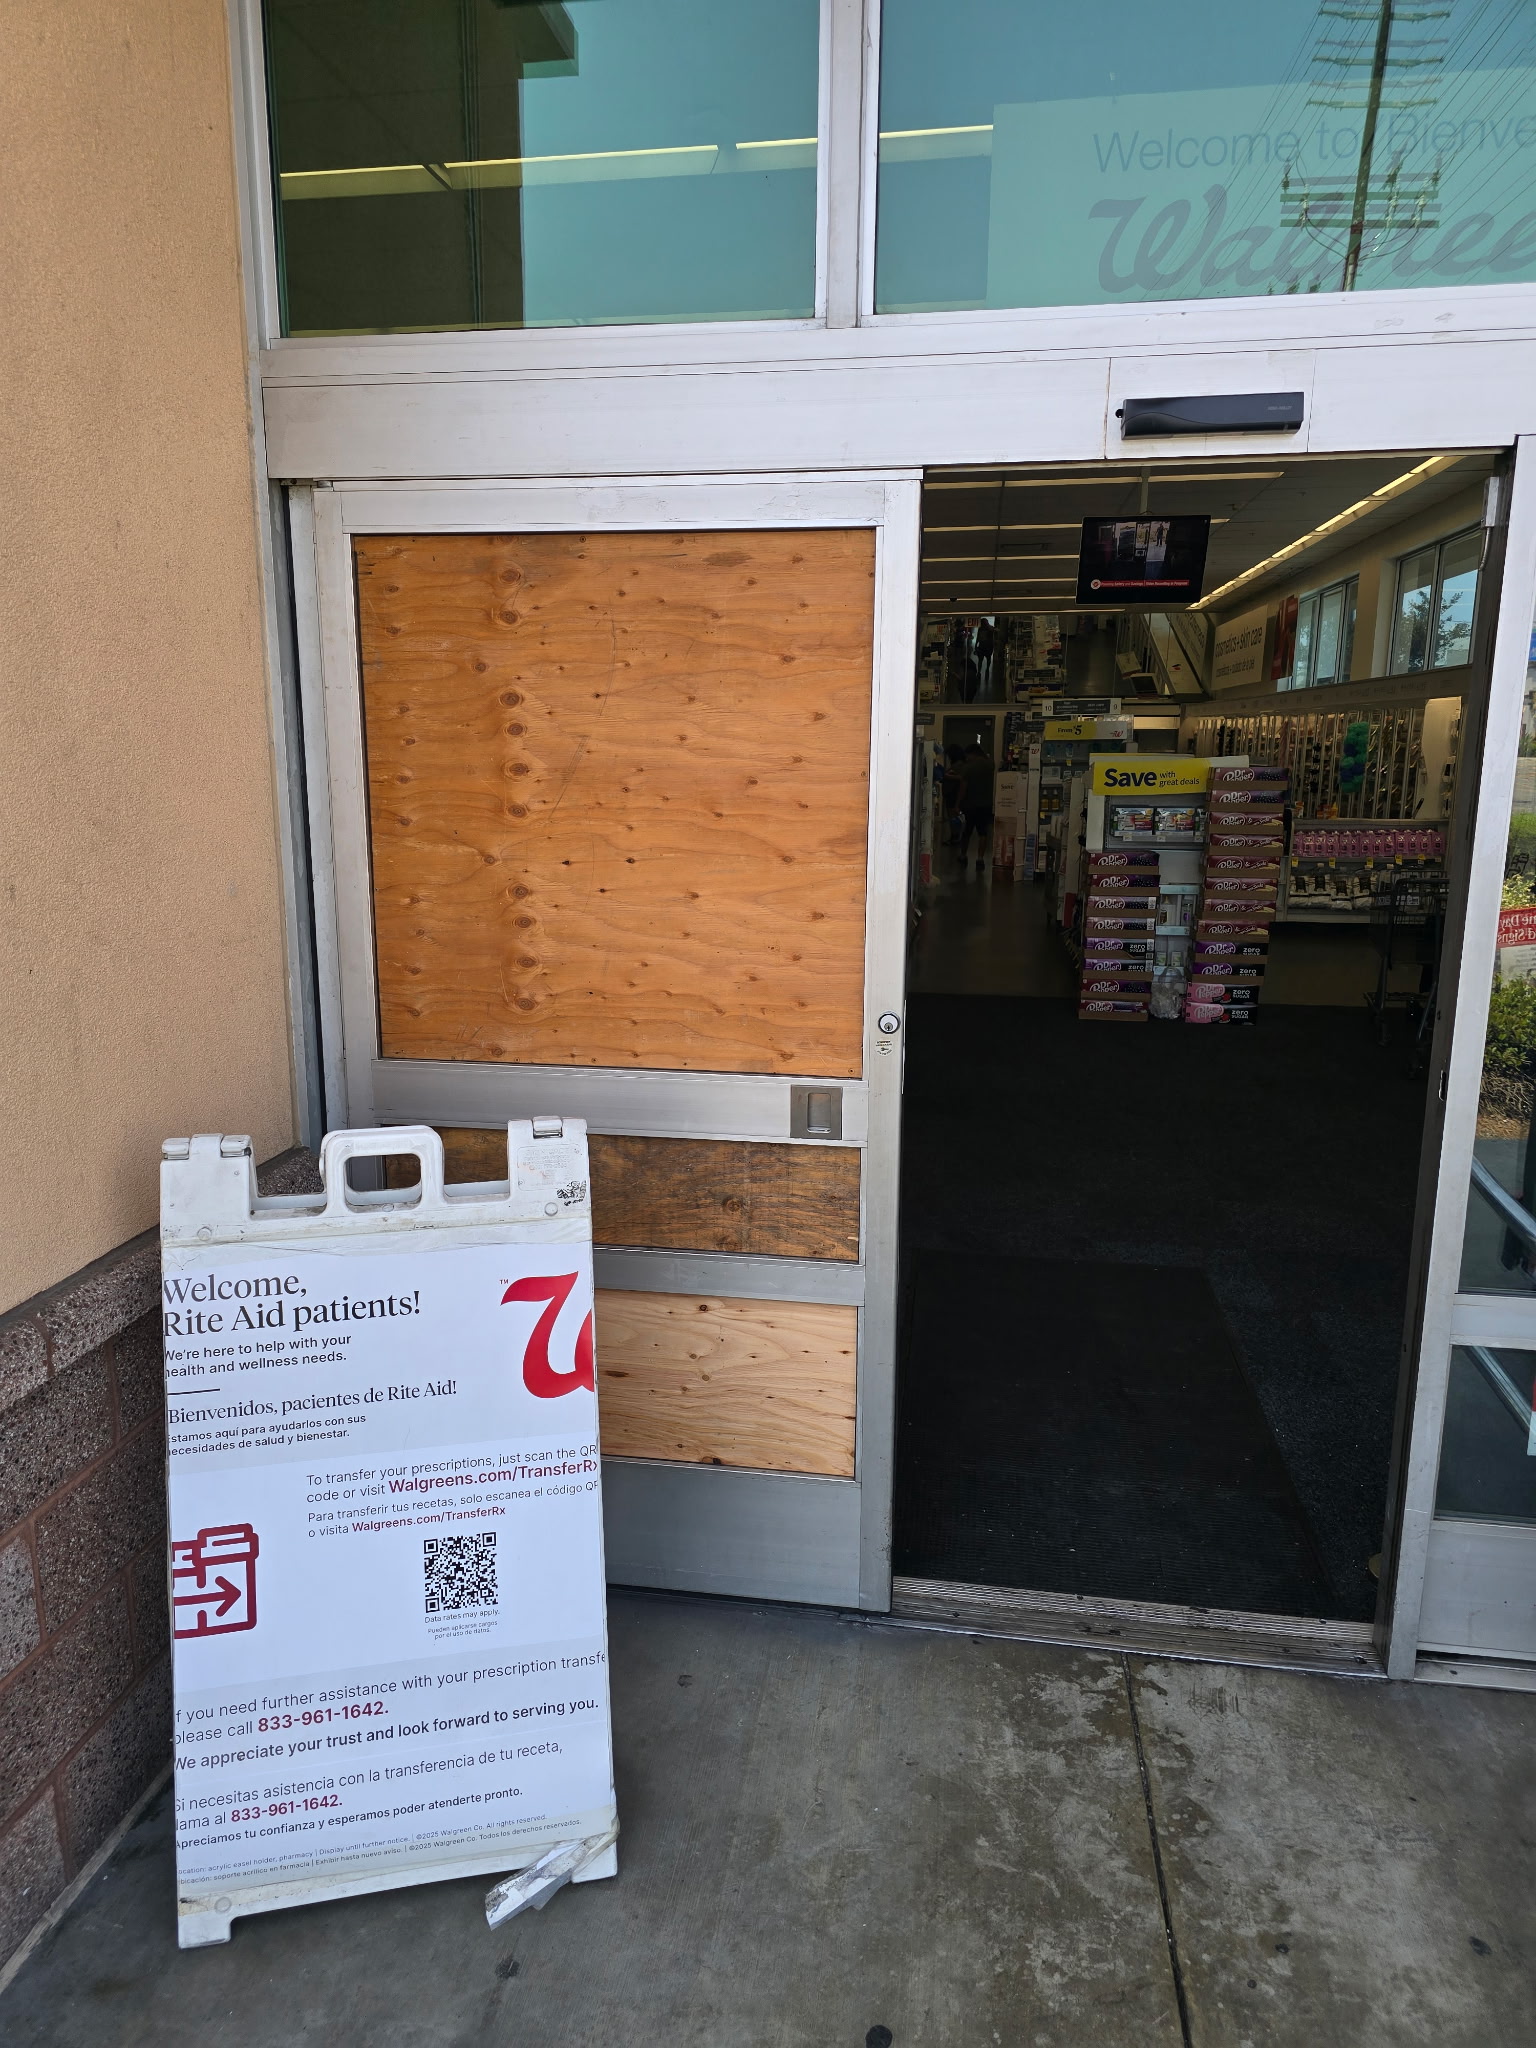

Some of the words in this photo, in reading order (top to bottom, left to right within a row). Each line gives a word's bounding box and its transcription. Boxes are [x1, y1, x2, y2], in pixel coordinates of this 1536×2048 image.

[1093, 128, 1299, 173] Welcome
[1316, 120, 1359, 160] to
[1104, 768, 1157, 787] Save
[1159, 771, 1176, 779] with
[1159, 779, 1178, 788] great
[1180, 777, 1200, 785] deals
[1196, 987, 1223, 999] Pepper
[1194, 1006, 1222, 1019] Pepper
[164, 1273, 307, 1304] Welcome,
[165, 1308, 224, 1336] Rite
[230, 1299, 286, 1332] Aid
[292, 1290, 420, 1333] patients!
[203, 1346, 235, 1358] here
[237, 1344, 252, 1355] to
[255, 1340, 285, 1354] help
[288, 1336, 318, 1350] with
[320, 1335, 352, 1350] your
[208, 1360, 235, 1374] and
[238, 1356, 299, 1371] wellness
[301, 1350, 347, 1365] needs.
[169, 1399, 278, 1424] Bienvenidos,
[281, 1393, 360, 1415] pacientes
[363, 1386, 384, 1404] de
[386, 1384, 420, 1401] Rite
[422, 1379, 457, 1398] Aid!
[168, 1432, 212, 1443] stamos
[214, 1426, 239, 1440] aquí
[241, 1425, 266, 1438] para
[268, 1419, 322, 1434] ayudarlos
[324, 1417, 345, 1427] con
[346, 1415, 367, 1424] sus
[237, 1439, 252, 1449] de
[254, 1434, 285, 1447] salud
[286, 1435, 294, 1446] y
[296, 1429, 350, 1442] bienestar.
[305, 1474, 323, 1486] To
[325, 1468, 377, 1484] transfer
[379, 1466, 408, 1481] your
[411, 1456, 495, 1477] prescriptions,
[498, 1452, 521, 1468] just
[524, 1451, 553, 1463] scan
[556, 1447, 576, 1460] the
[306, 1489, 339, 1503] code
[342, 1488, 356, 1499] or
[359, 1483, 386, 1497] visit
[308, 1512, 334, 1523] Para
[336, 1503, 389, 1520] transferir
[391, 1503, 410, 1513] tus
[412, 1497, 457, 1511] recetas,
[460, 1493, 483, 1505] solo
[485, 1489, 531, 1502] escanea
[533, 1486, 543, 1497] el
[546, 1483, 583, 1496] código
[308, 1529, 316, 1538] o
[318, 1524, 349, 1536] visita
[351, 1505, 506, 1533] Walgreens.com/TransferRx
[424, 1615, 442, 1624] Data
[442, 1613, 462, 1621] rates
[462, 1611, 478, 1619] may
[479, 1608, 500, 1618] apply.
[185, 1707, 214, 1724] you
[219, 1699, 257, 1717] need
[261, 1692, 315, 1711] further
[318, 1681, 397, 1702] assistance
[401, 1676, 432, 1690] with
[436, 1671, 469, 1689] your
[473, 1660, 557, 1684] prescription
[200, 1744, 284, 1769] appreciate
[287, 1738, 323, 1757] your
[325, 1730, 363, 1748] trust
[365, 1725, 394, 1742] and
[398, 1721, 430, 1738] look
[432, 1711, 490, 1732] forward
[493, 1710, 509, 1722] to
[511, 1702, 565, 1720] serving
[568, 1699, 599, 1715] you.
[227, 1720, 253, 1737] call
[257, 1701, 389, 1733] 833-961-1642.
[189, 1789, 259, 1810] necesitas
[263, 1776, 335, 1799] asistencia
[338, 1773, 365, 1787] con
[368, 1769, 380, 1783] la
[384, 1755, 475, 1780] transferencia
[478, 1752, 496, 1765] de
[499, 1749, 513, 1761] tu
[517, 1742, 563, 1759] receta,
[214, 1811, 226, 1825] al
[230, 1794, 343, 1823] 833-961-1642.
[243, 1829, 257, 1839] tu
[259, 1821, 315, 1837] confianza
[317, 1819, 325, 1830] y
[327, 1809, 390, 1826] esperamos
[392, 1803, 426, 1818] poder
[427, 1793, 482, 1810] atenderte
[484, 1787, 523, 1804] pronto.
[207, 1861, 231, 1873] acrylic
[278, 1849, 313, 1862] pharmacy
[319, 1844, 344, 1856] Display
[362, 1838, 386, 1848] further
[415, 1830, 438, 1840] ©2025
[440, 1825, 471, 1837] Walgreen
[473, 1823, 484, 1831] Co.
[486, 1821, 494, 1829] All
[408, 1841, 431, 1850] ©2025
[433, 1836, 464, 1848] Walgreen
[466, 1834, 477, 1842] Co.
[478, 1830, 499, 1840] Todos
